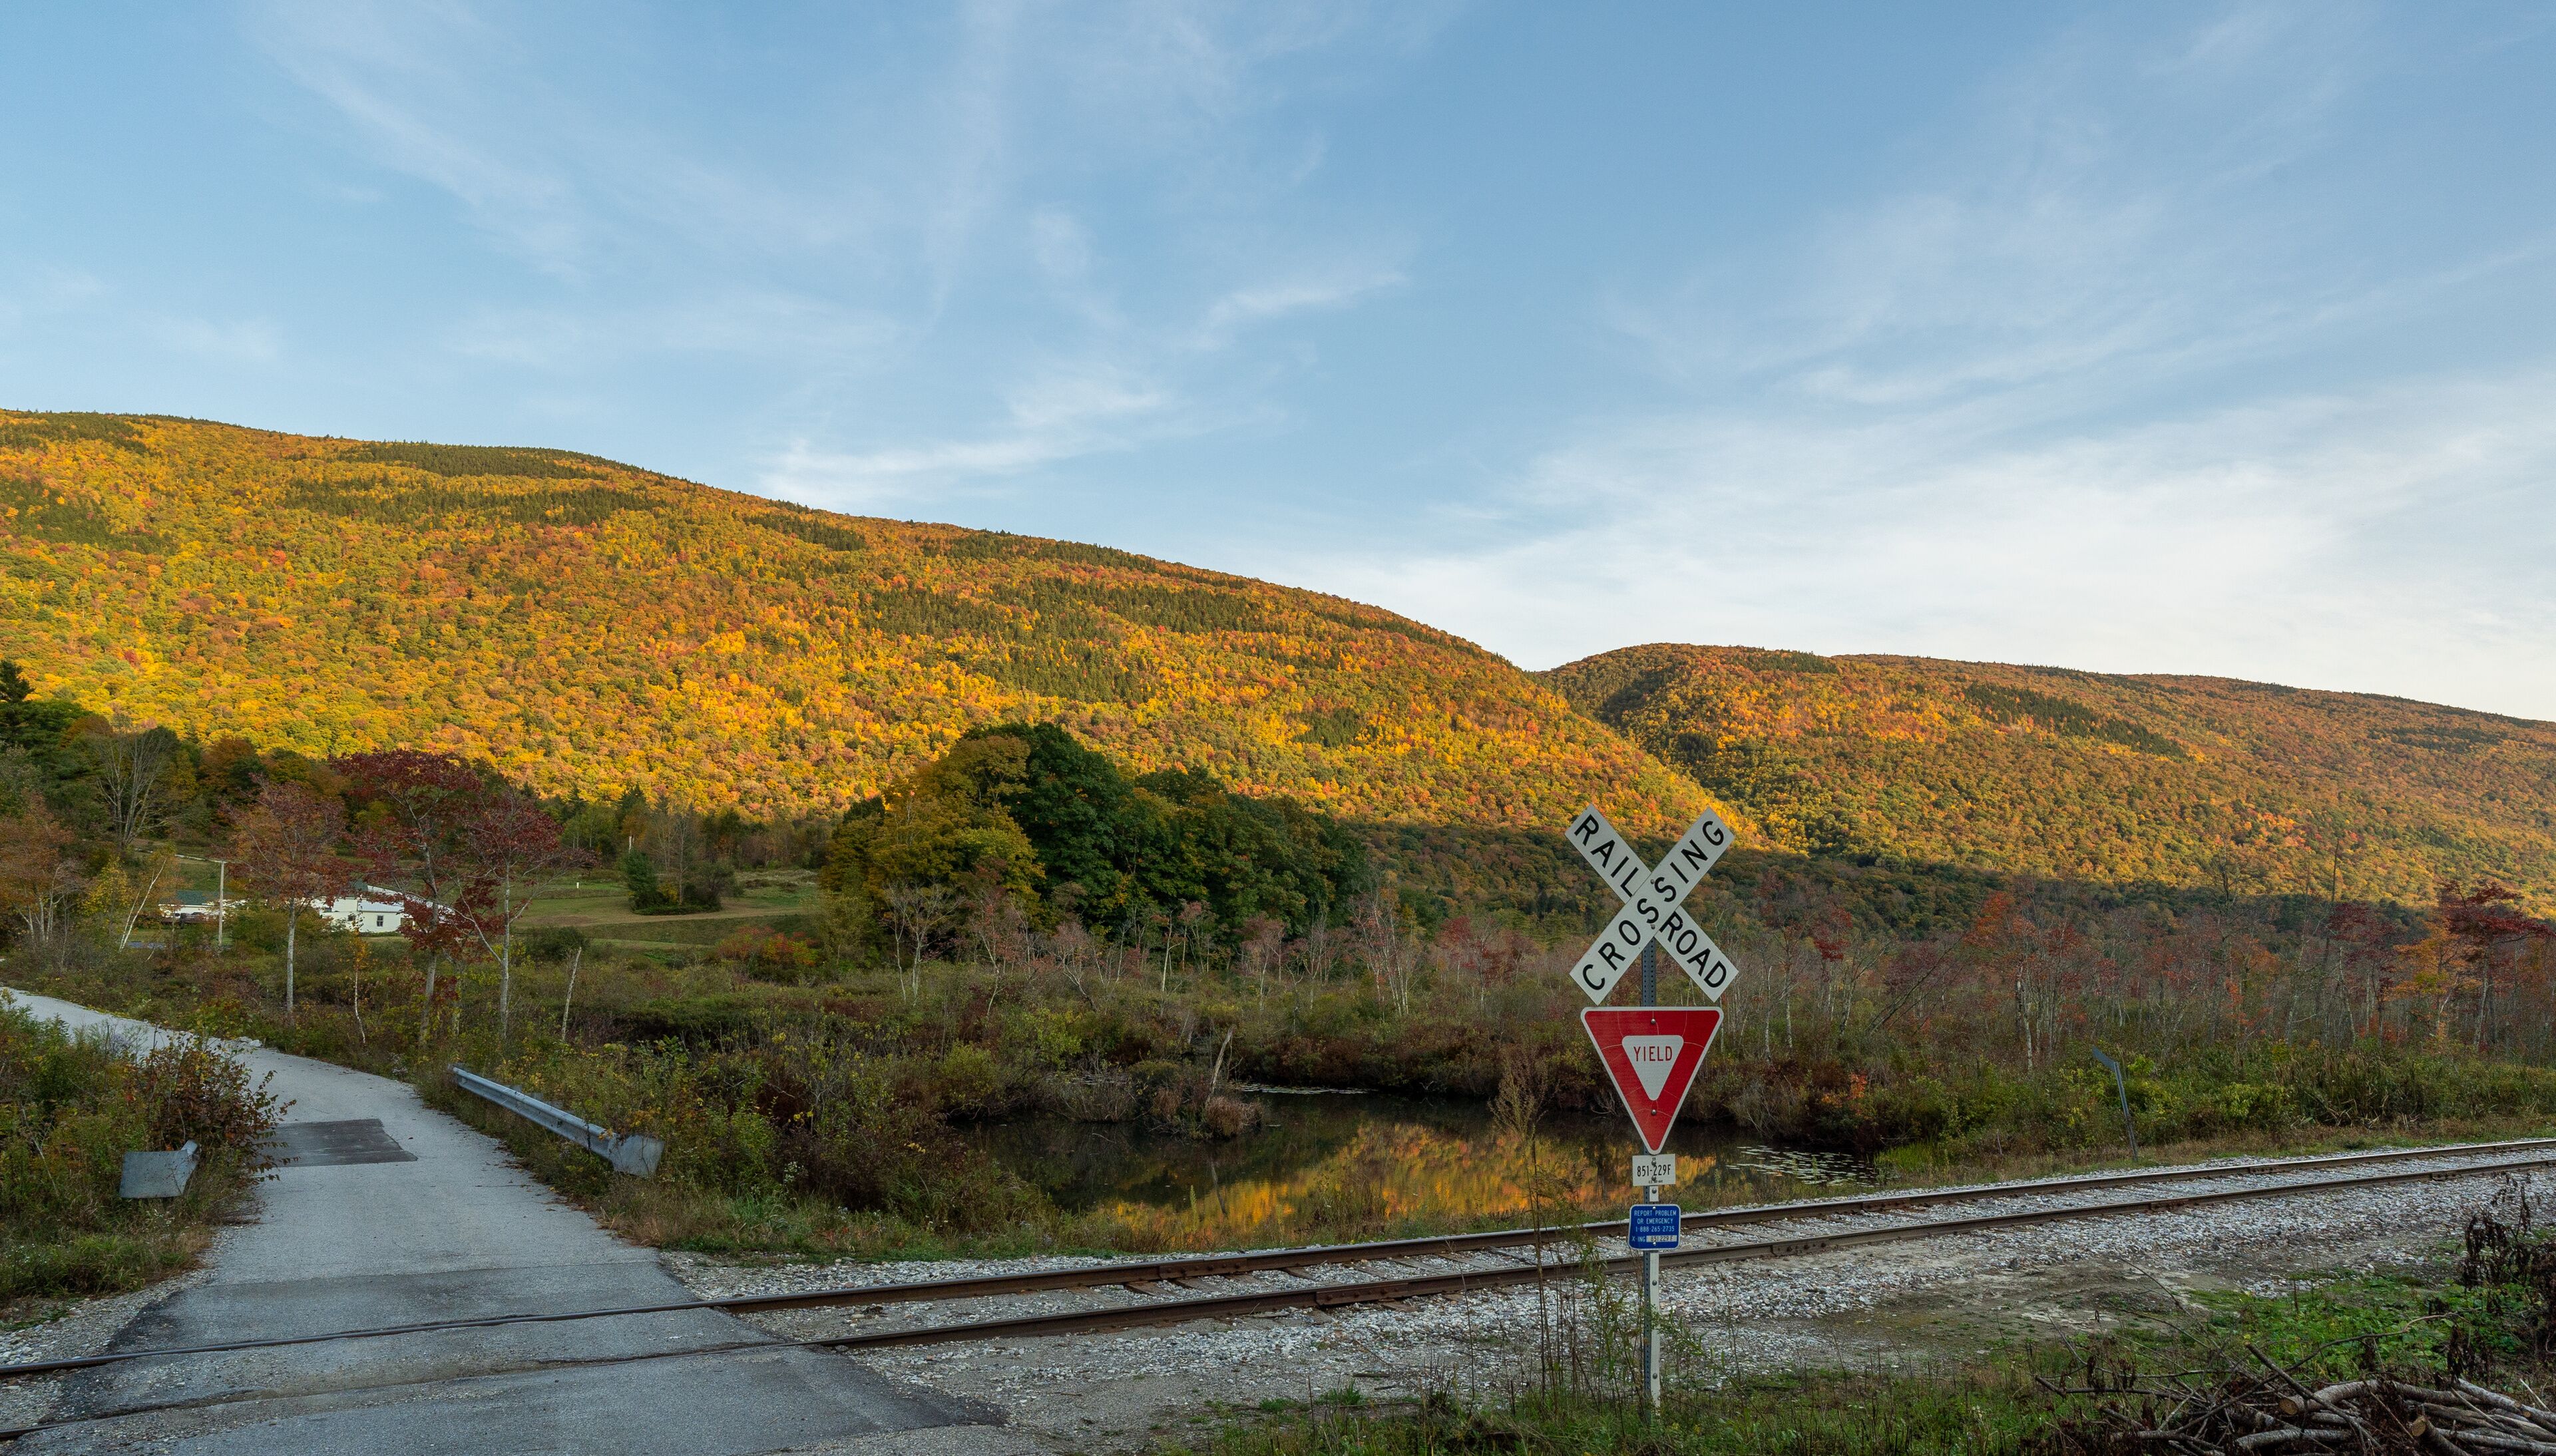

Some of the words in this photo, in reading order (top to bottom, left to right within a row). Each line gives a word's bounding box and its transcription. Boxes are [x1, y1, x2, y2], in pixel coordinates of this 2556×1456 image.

[1574, 814, 1639, 898] RAIL
[1659, 911, 1727, 988] ROAD
[1582, 820, 1724, 991] CROSSING
[1633, 1046, 1673, 1061] YIELD
[1637, 1165, 1671, 1177] 851-229F
